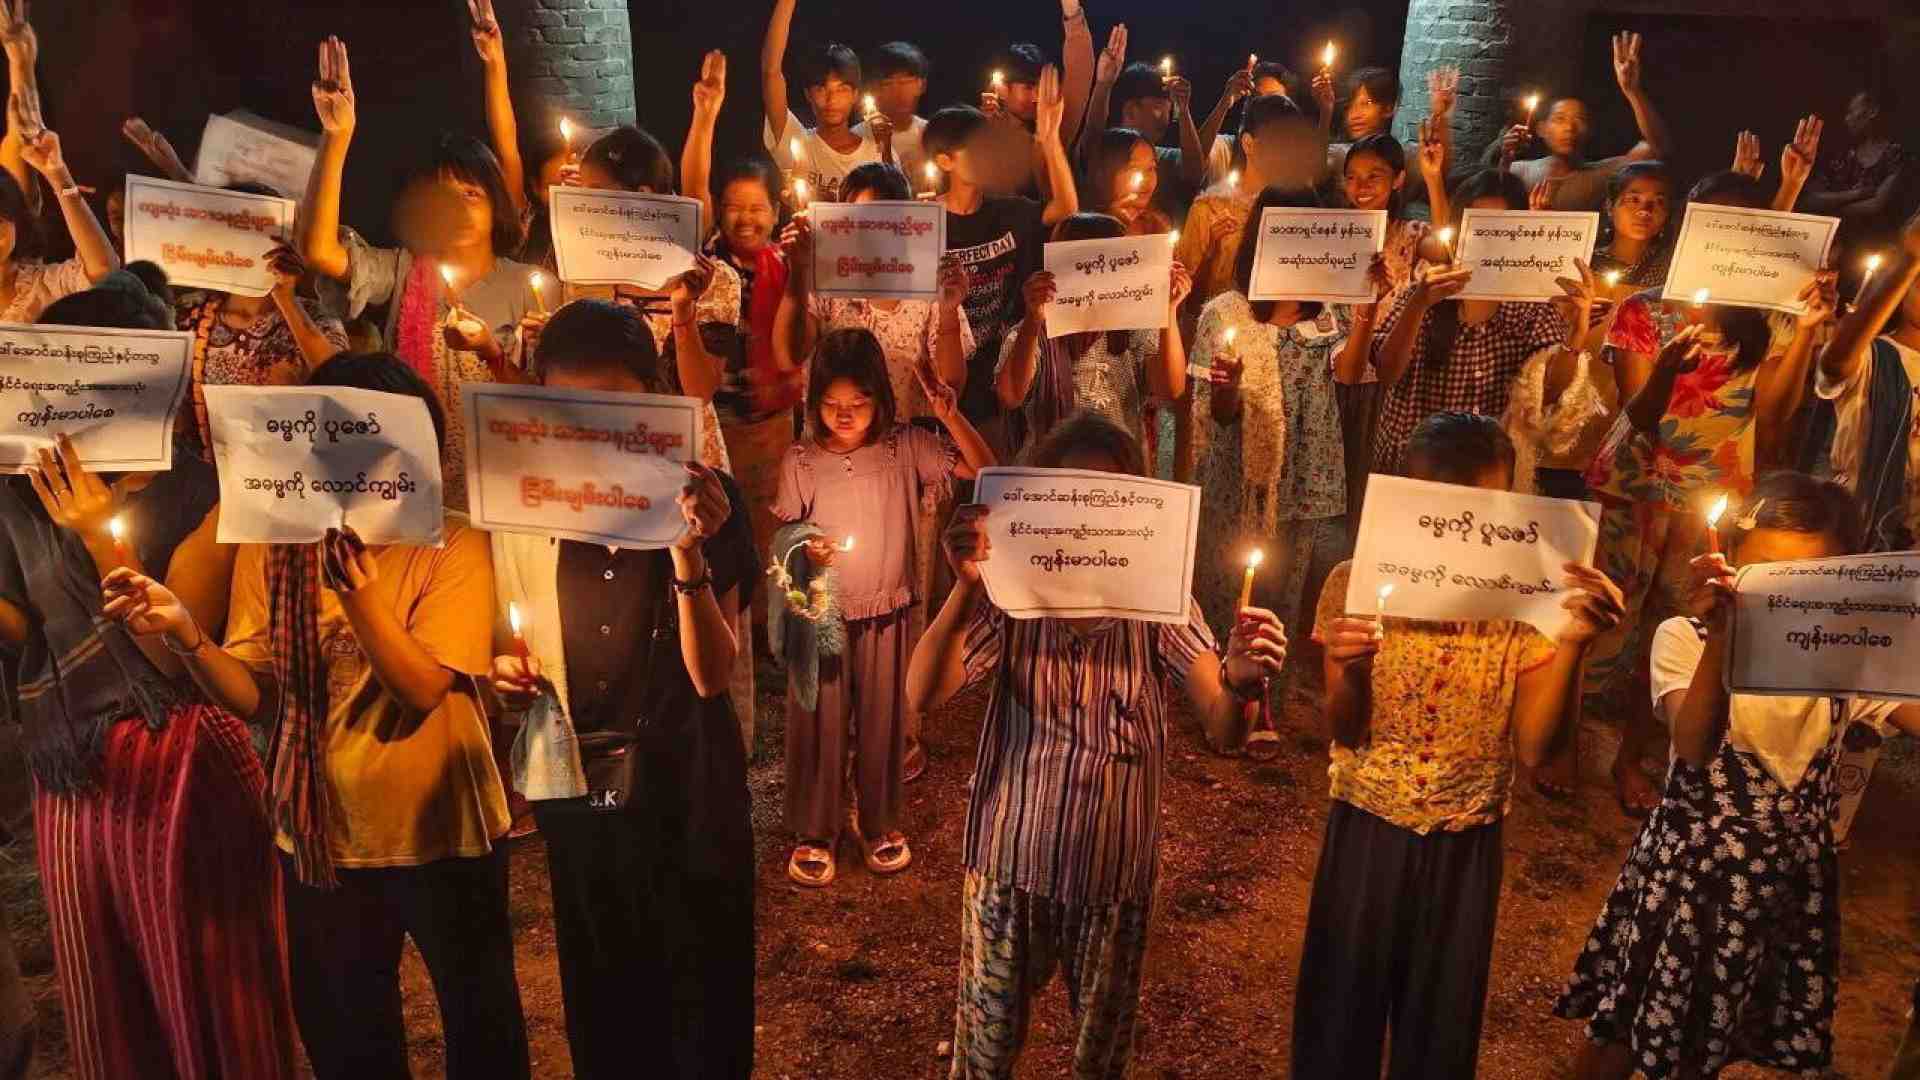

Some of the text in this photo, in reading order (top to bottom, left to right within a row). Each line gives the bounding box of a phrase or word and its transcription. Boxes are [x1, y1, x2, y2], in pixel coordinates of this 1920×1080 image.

[267, 410, 381, 442] ဓမ္မကို ပူဇော်
[1030, 548, 1129, 573] ကျန်းမာပါစေ
